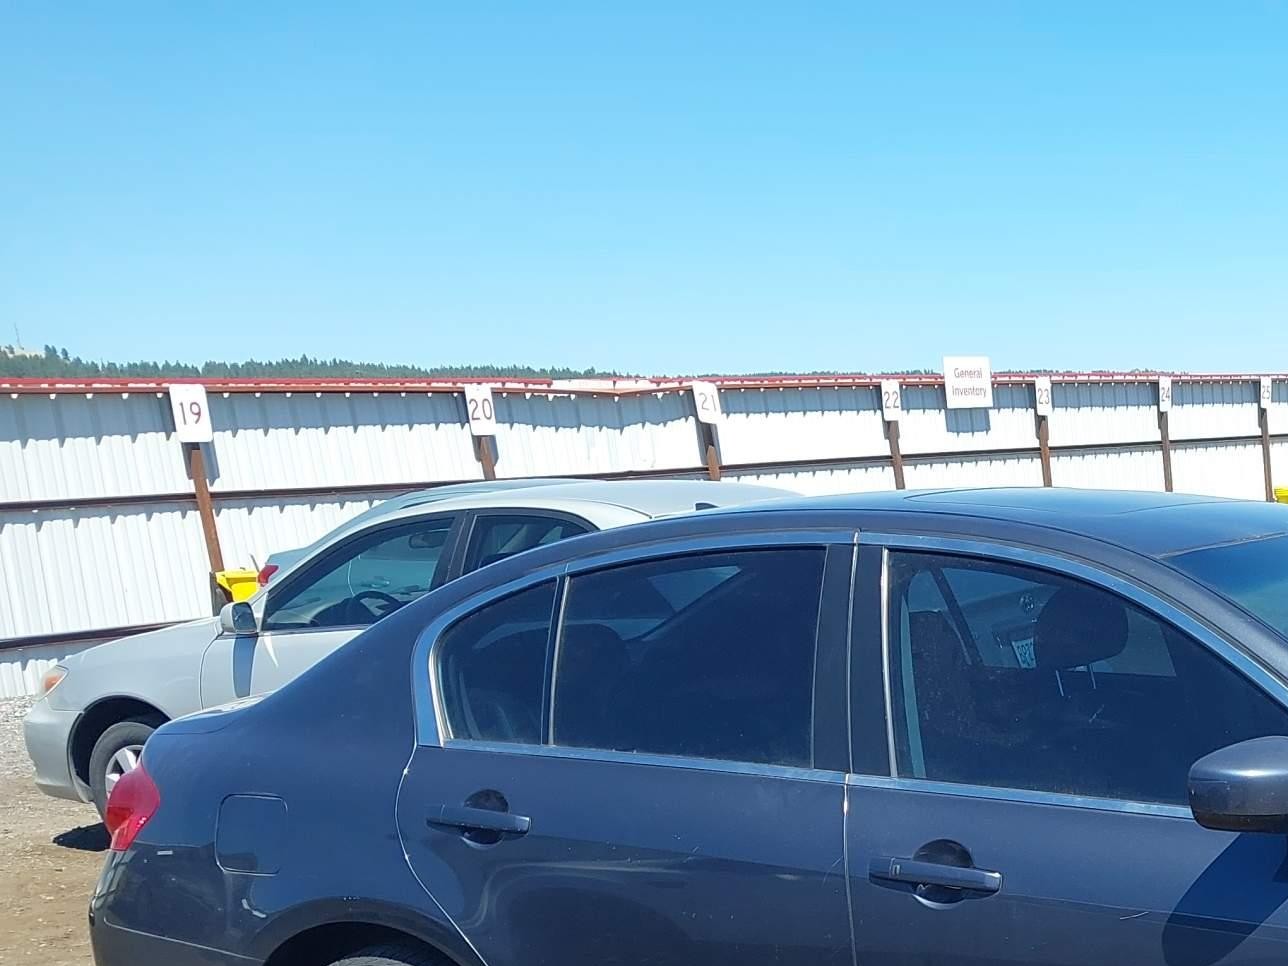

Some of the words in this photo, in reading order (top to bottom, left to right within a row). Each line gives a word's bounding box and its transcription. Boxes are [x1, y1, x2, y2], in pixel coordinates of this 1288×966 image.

[953, 367, 983, 379] General
[883, 390, 900, 409] 22
[952, 385, 987, 398] Inventory
[1037, 387, 1050, 405] 23
[1161, 386, 1171, 402] 24
[1261, 384, 1271, 401] 25
[468, 398, 493, 421] 20
[698, 392, 717, 412] 21
[179, 401, 202, 425] 19
